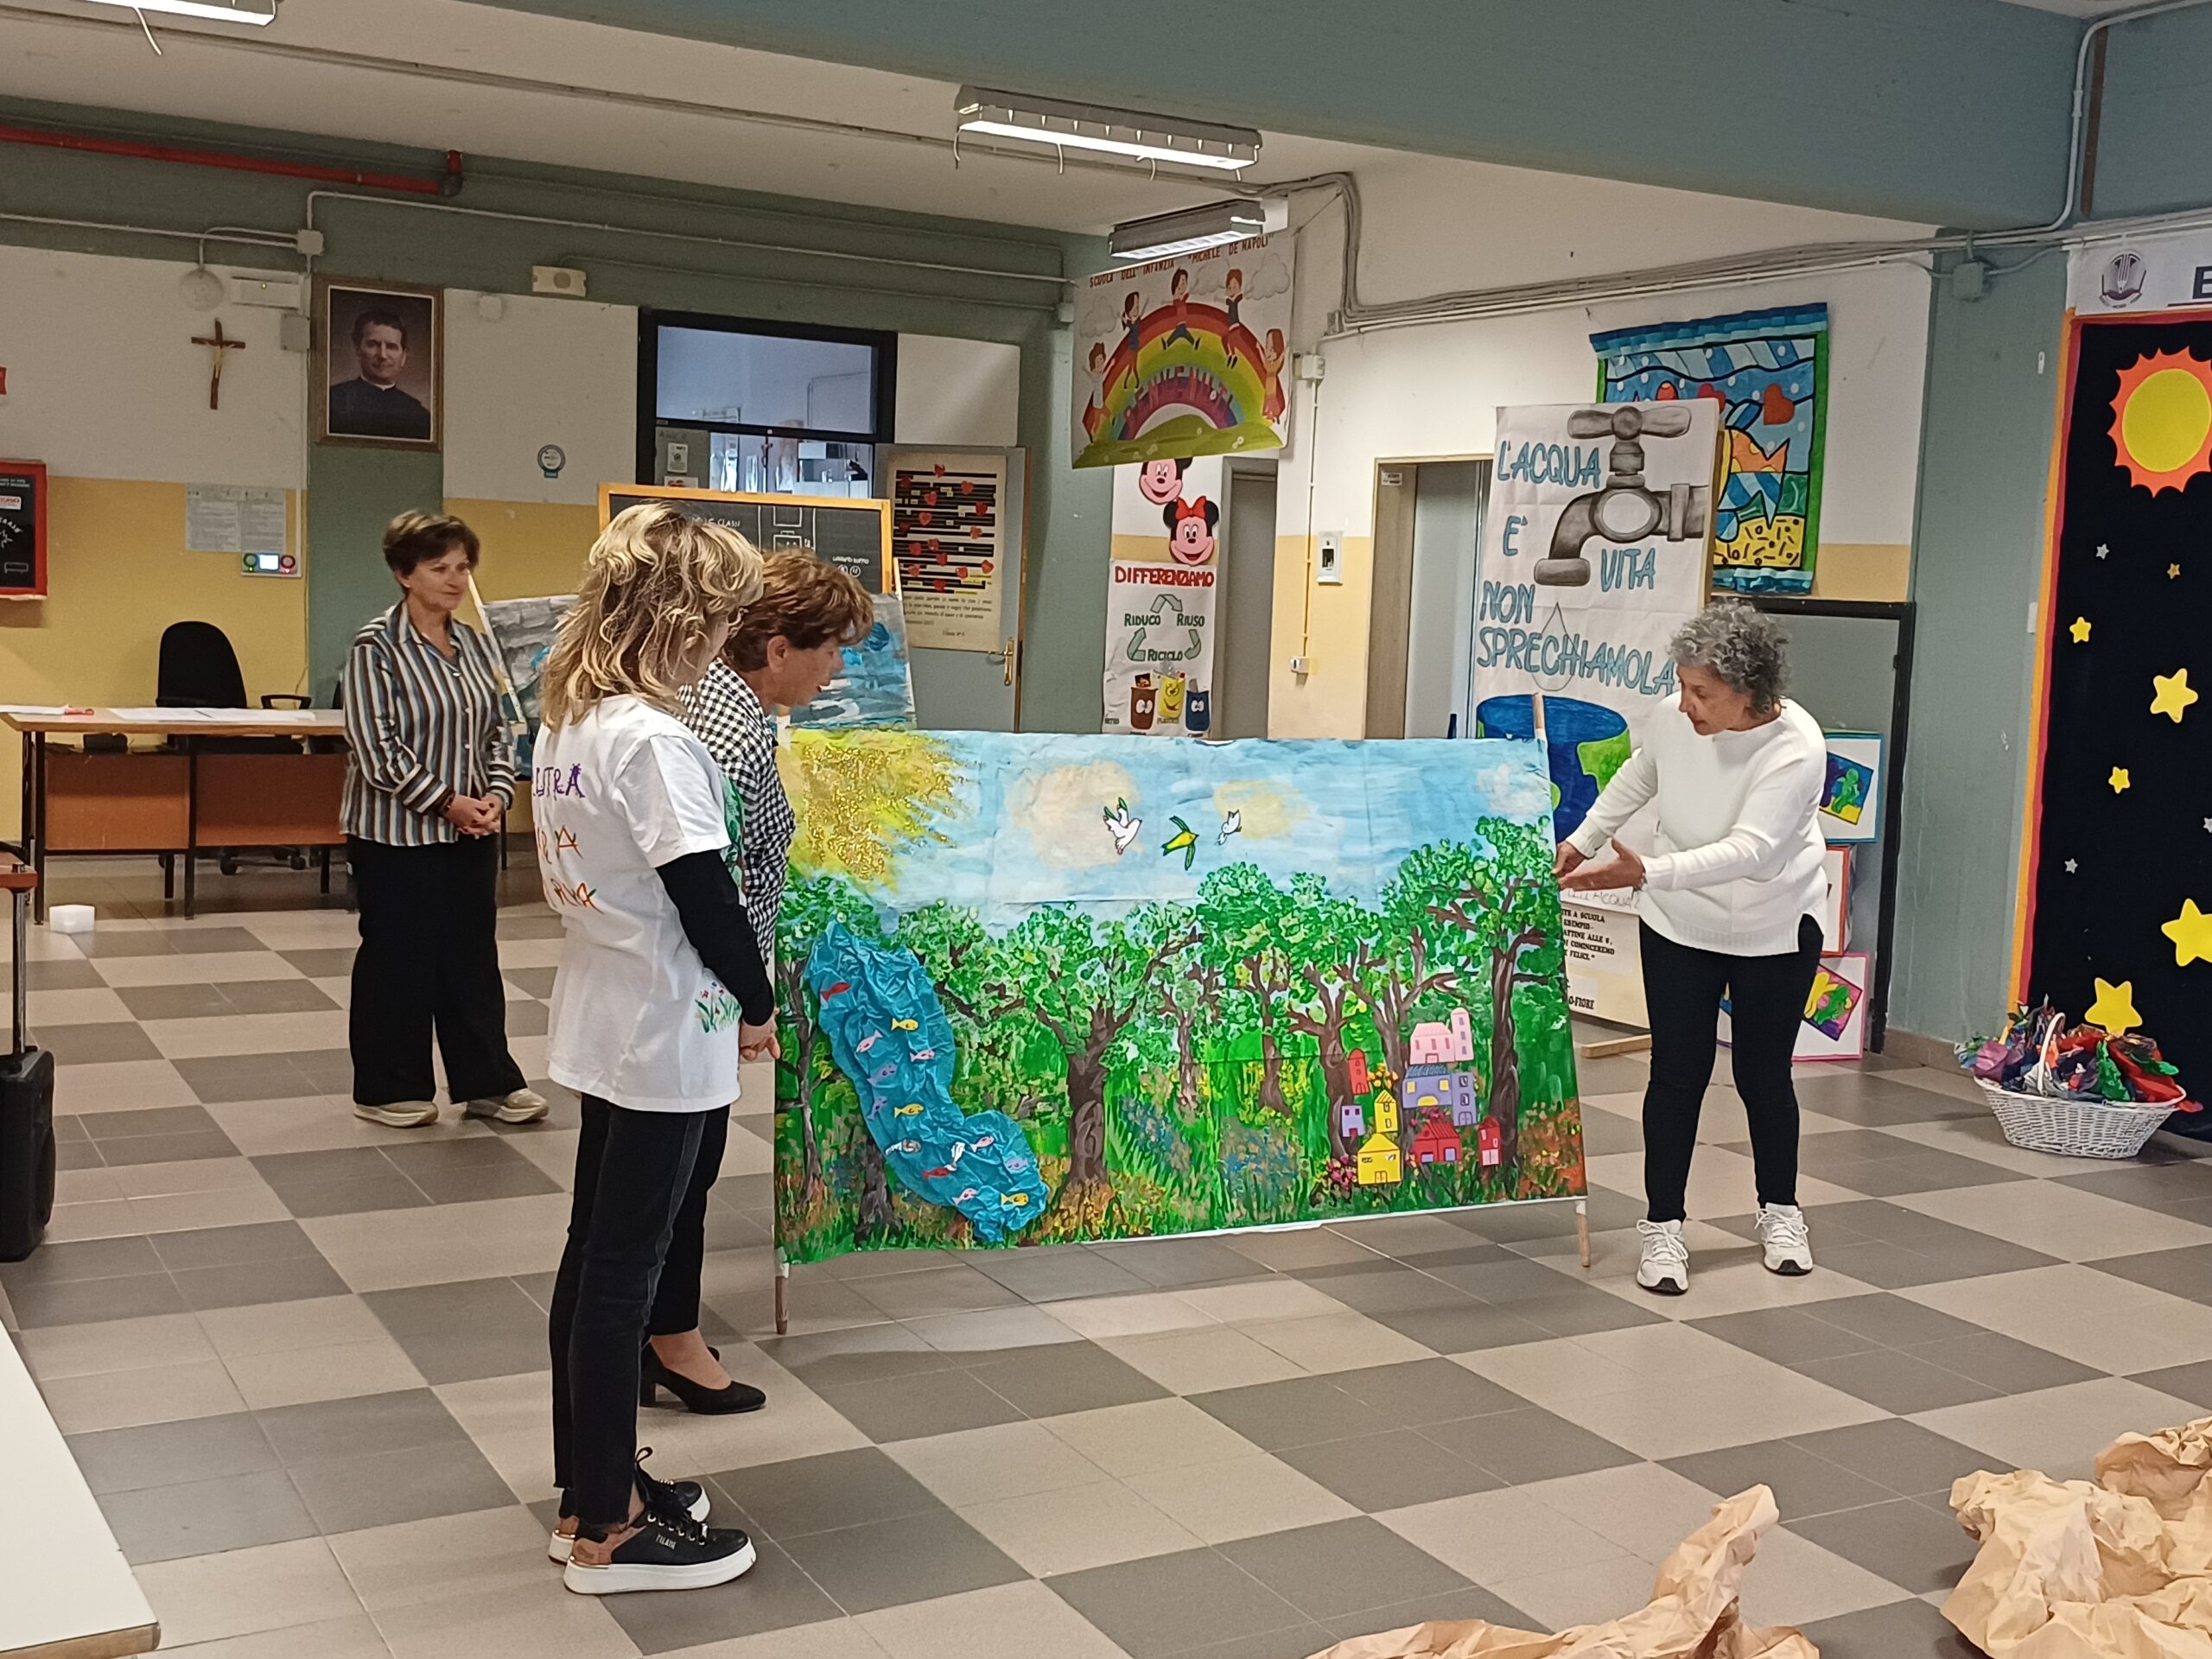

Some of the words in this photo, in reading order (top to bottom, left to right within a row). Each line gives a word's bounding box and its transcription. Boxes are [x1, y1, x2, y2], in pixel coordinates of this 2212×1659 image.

[1089, 272, 1114, 289] SCUOLA
[1229, 242, 1238, 256] DE
[1497, 439, 1601, 489] L'ACQUA
[1600, 547, 1656, 593] VITA
[1123, 613, 1161, 627] RIDUCO
[1176, 613, 1205, 627] RIUSO
[1479, 580, 1535, 625] NON
[1477, 626, 1677, 696] SPRECHIAMOLA
[1580, 912, 1605, 924] SCUOLA
[1586, 933, 1604, 944] ALLE
